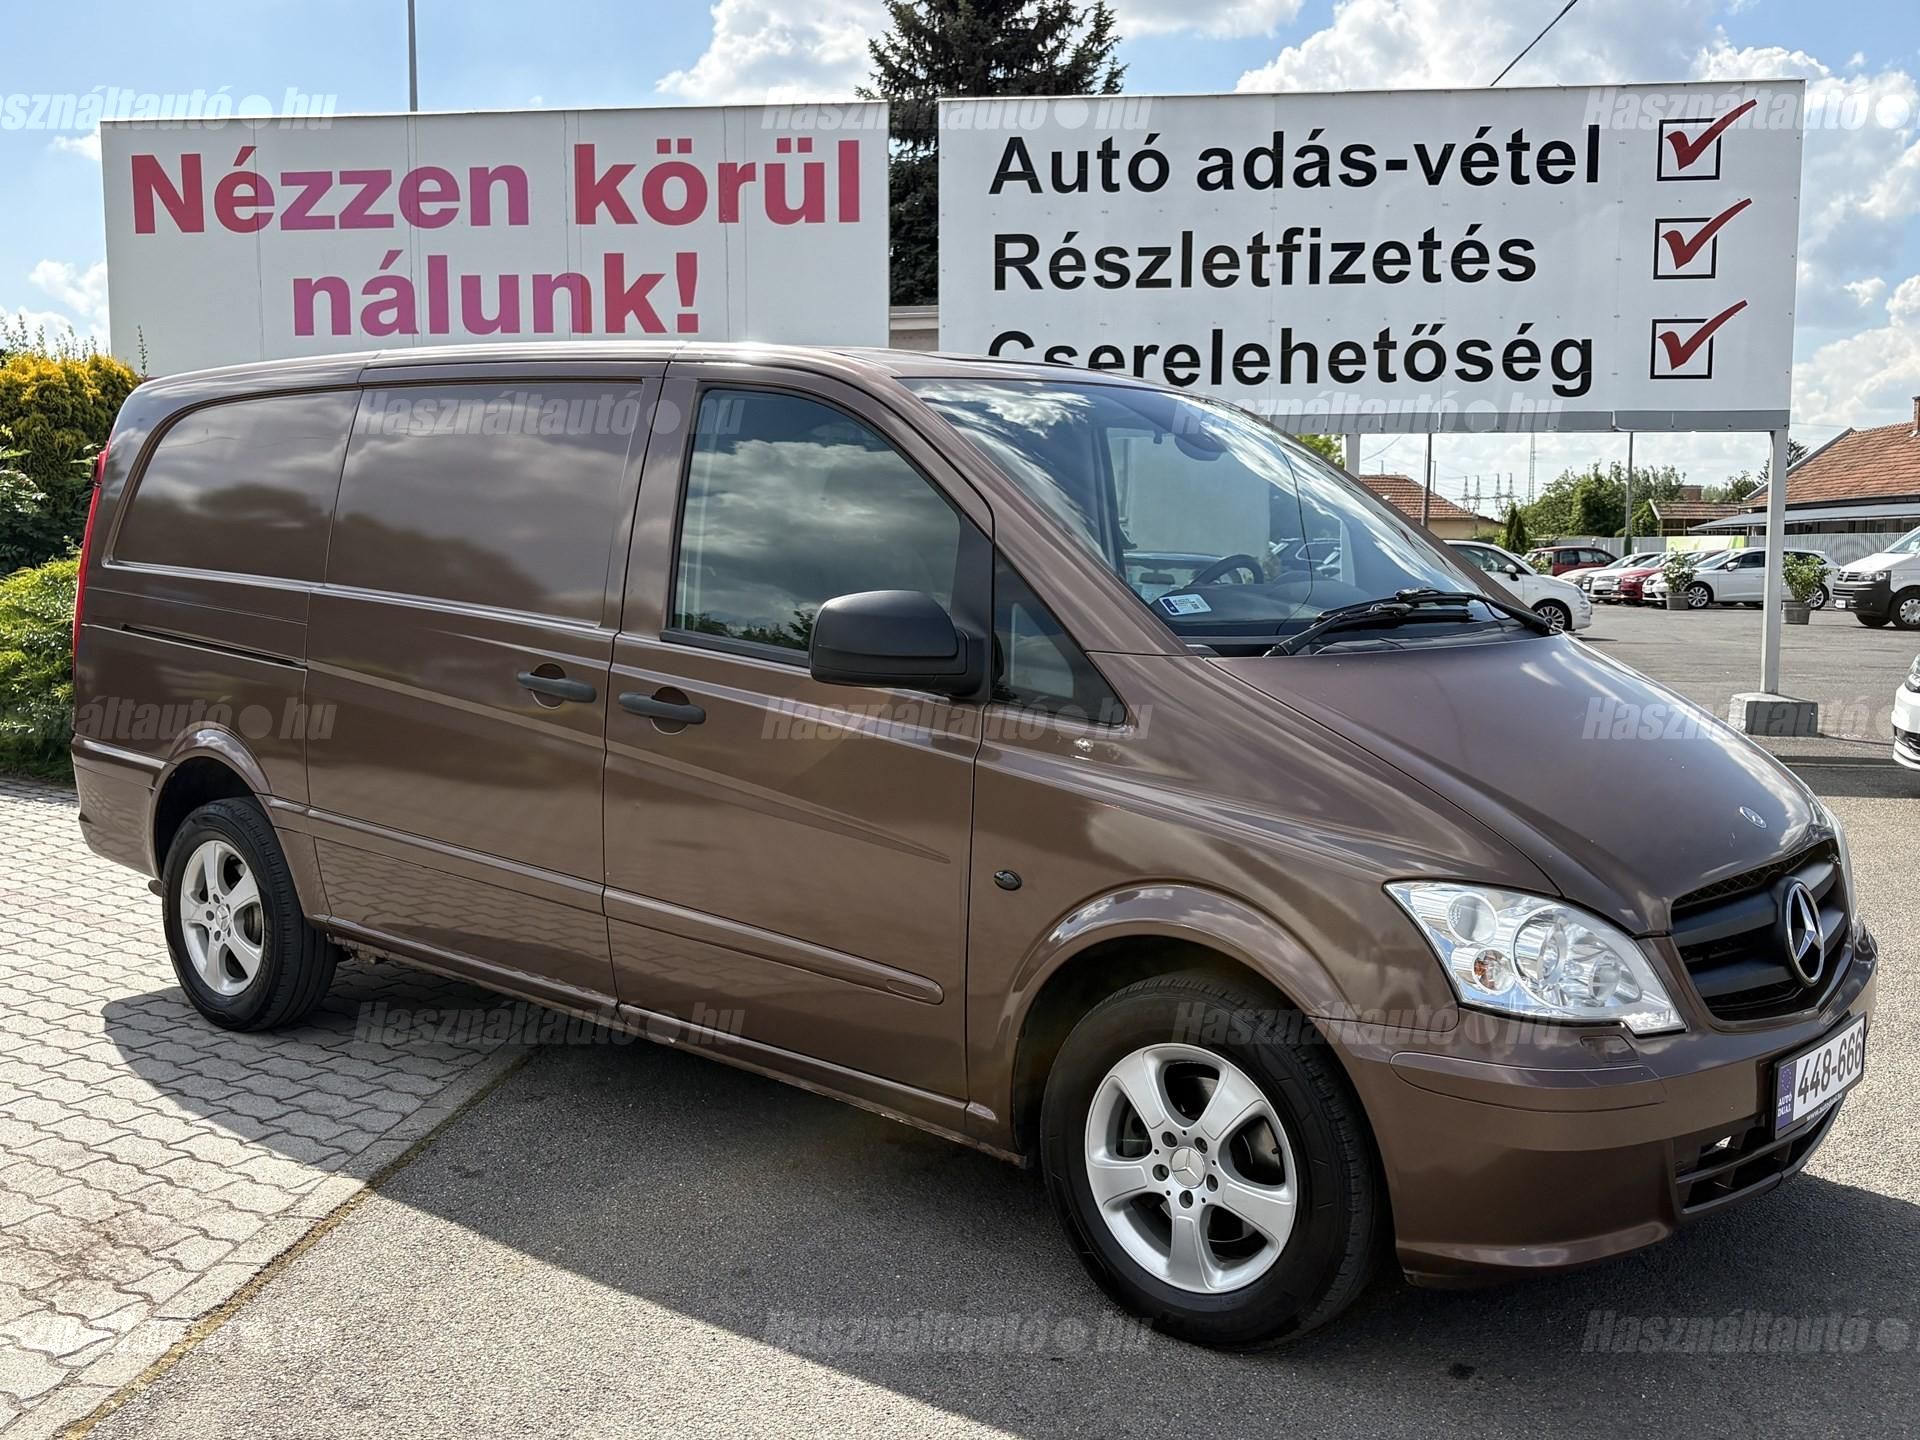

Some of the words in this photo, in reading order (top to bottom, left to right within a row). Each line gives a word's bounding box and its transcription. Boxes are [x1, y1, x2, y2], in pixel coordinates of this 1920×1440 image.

[131, 146, 530, 235] Nézzen
[574, 138, 862, 227] körül
[988, 131, 1170, 195] Autó
[1197, 124, 1601, 191] adás-vétel
[293, 249, 701, 337] nálunk!
[994, 223, 1537, 291] Részletfizetés
[1797, 1026, 1863, 1105] 448-666
